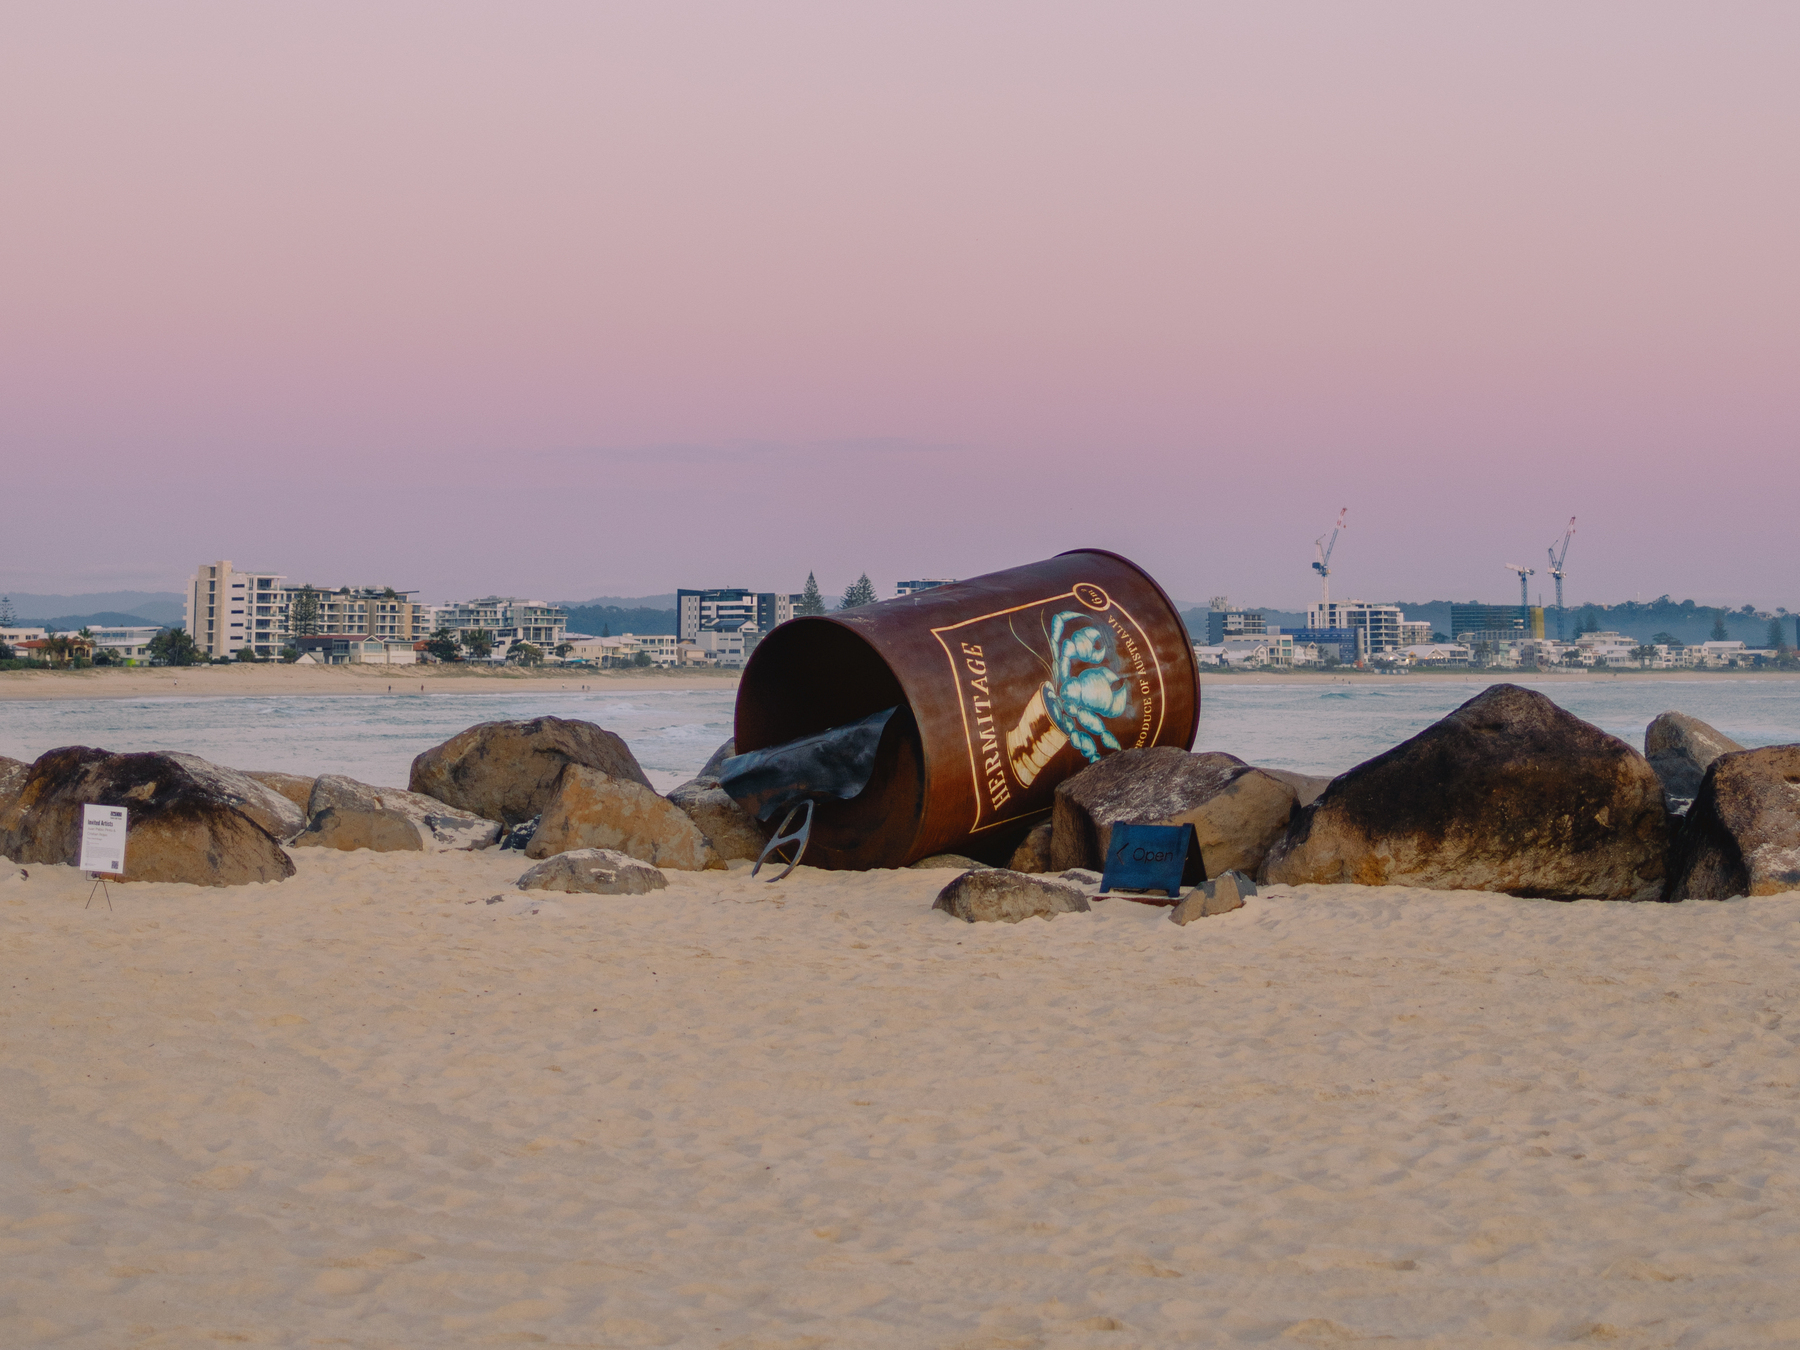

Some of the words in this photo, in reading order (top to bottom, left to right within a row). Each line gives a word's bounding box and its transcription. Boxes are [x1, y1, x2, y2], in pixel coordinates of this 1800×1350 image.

[1107, 614, 1147, 675] AUSTRALIA
[1139, 679, 1150, 695] OF
[961, 642, 1011, 811] HERMITAGE
[1134, 697, 1152, 749] RODUCE
[1133, 847, 1174, 864] Open
